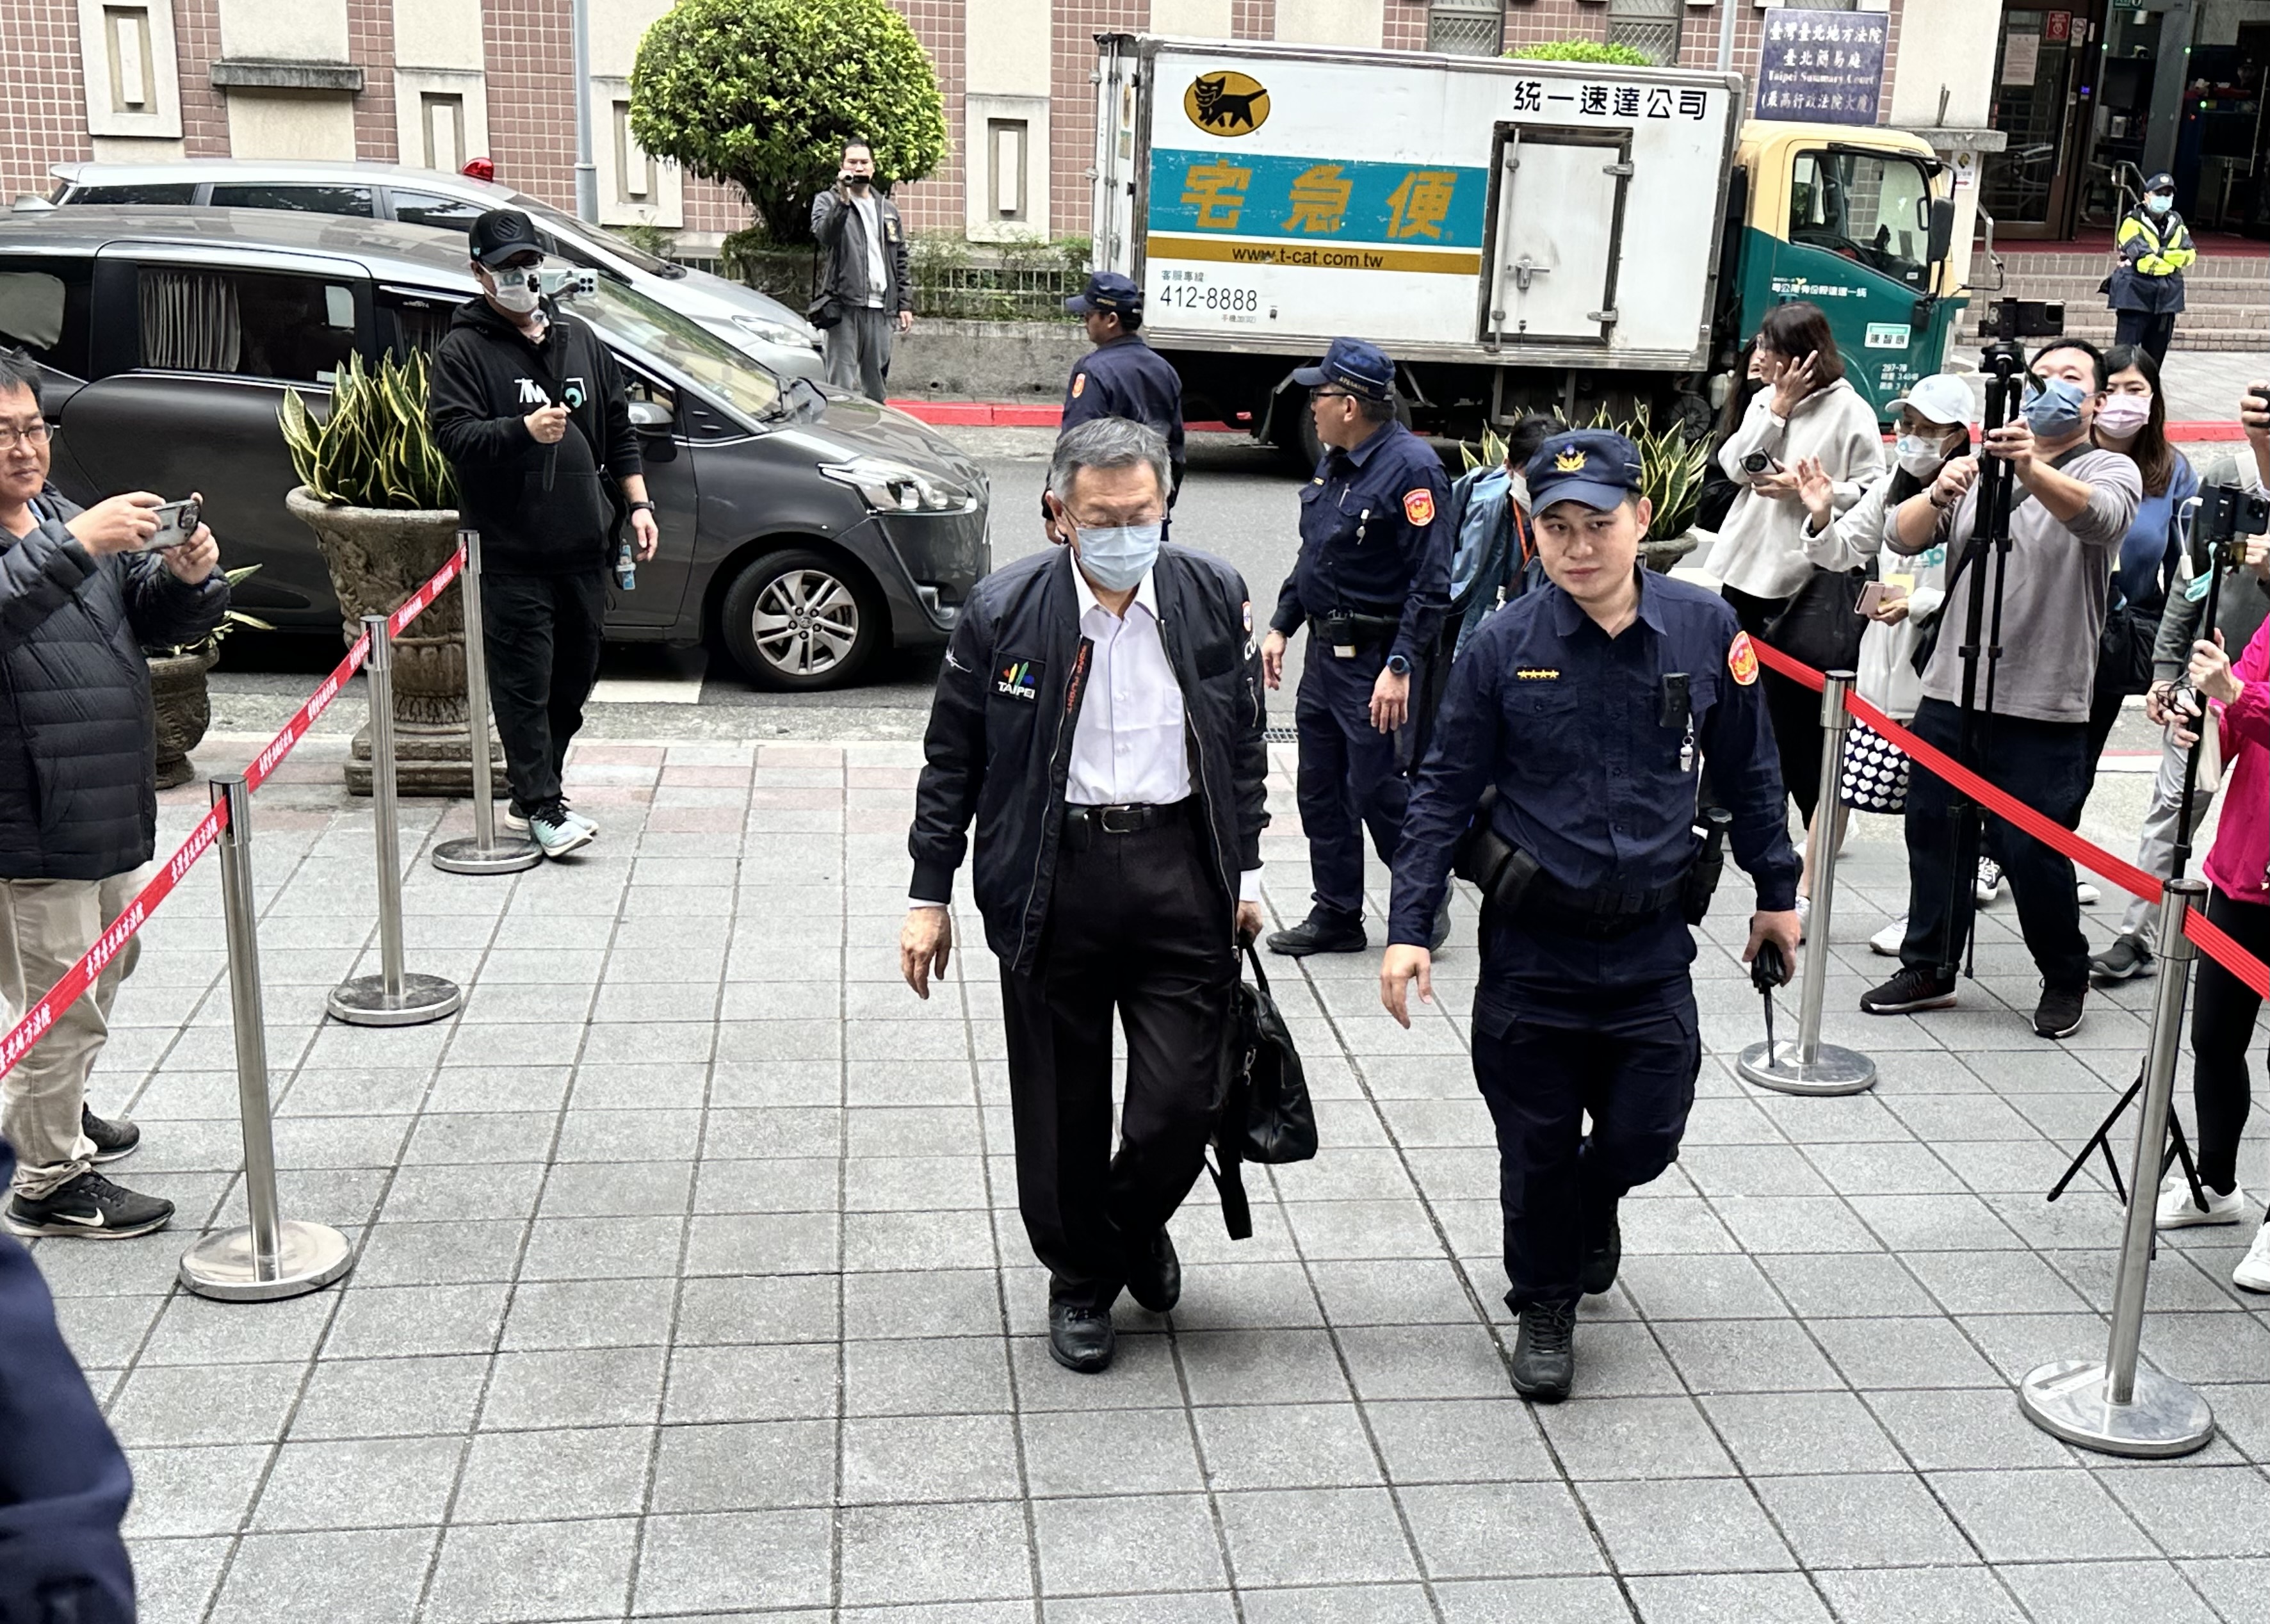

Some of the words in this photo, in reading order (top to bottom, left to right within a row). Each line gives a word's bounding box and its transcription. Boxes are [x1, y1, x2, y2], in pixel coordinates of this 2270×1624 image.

[1769, 20, 1883, 44] 臺灣臺北地方法院
[1769, 70, 1798, 83] Taipei
[1801, 71, 1844, 85] Summary
[1847, 74, 1874, 85] Court
[1513, 81, 1707, 120] 統一速達公司
[1180, 159, 1458, 240] 宅急便
[1160, 285, 1257, 311] 412-8888
[998, 681, 1035, 699] TAIPEI
[85, 901, 145, 980] 臺灣臺北地方法院
